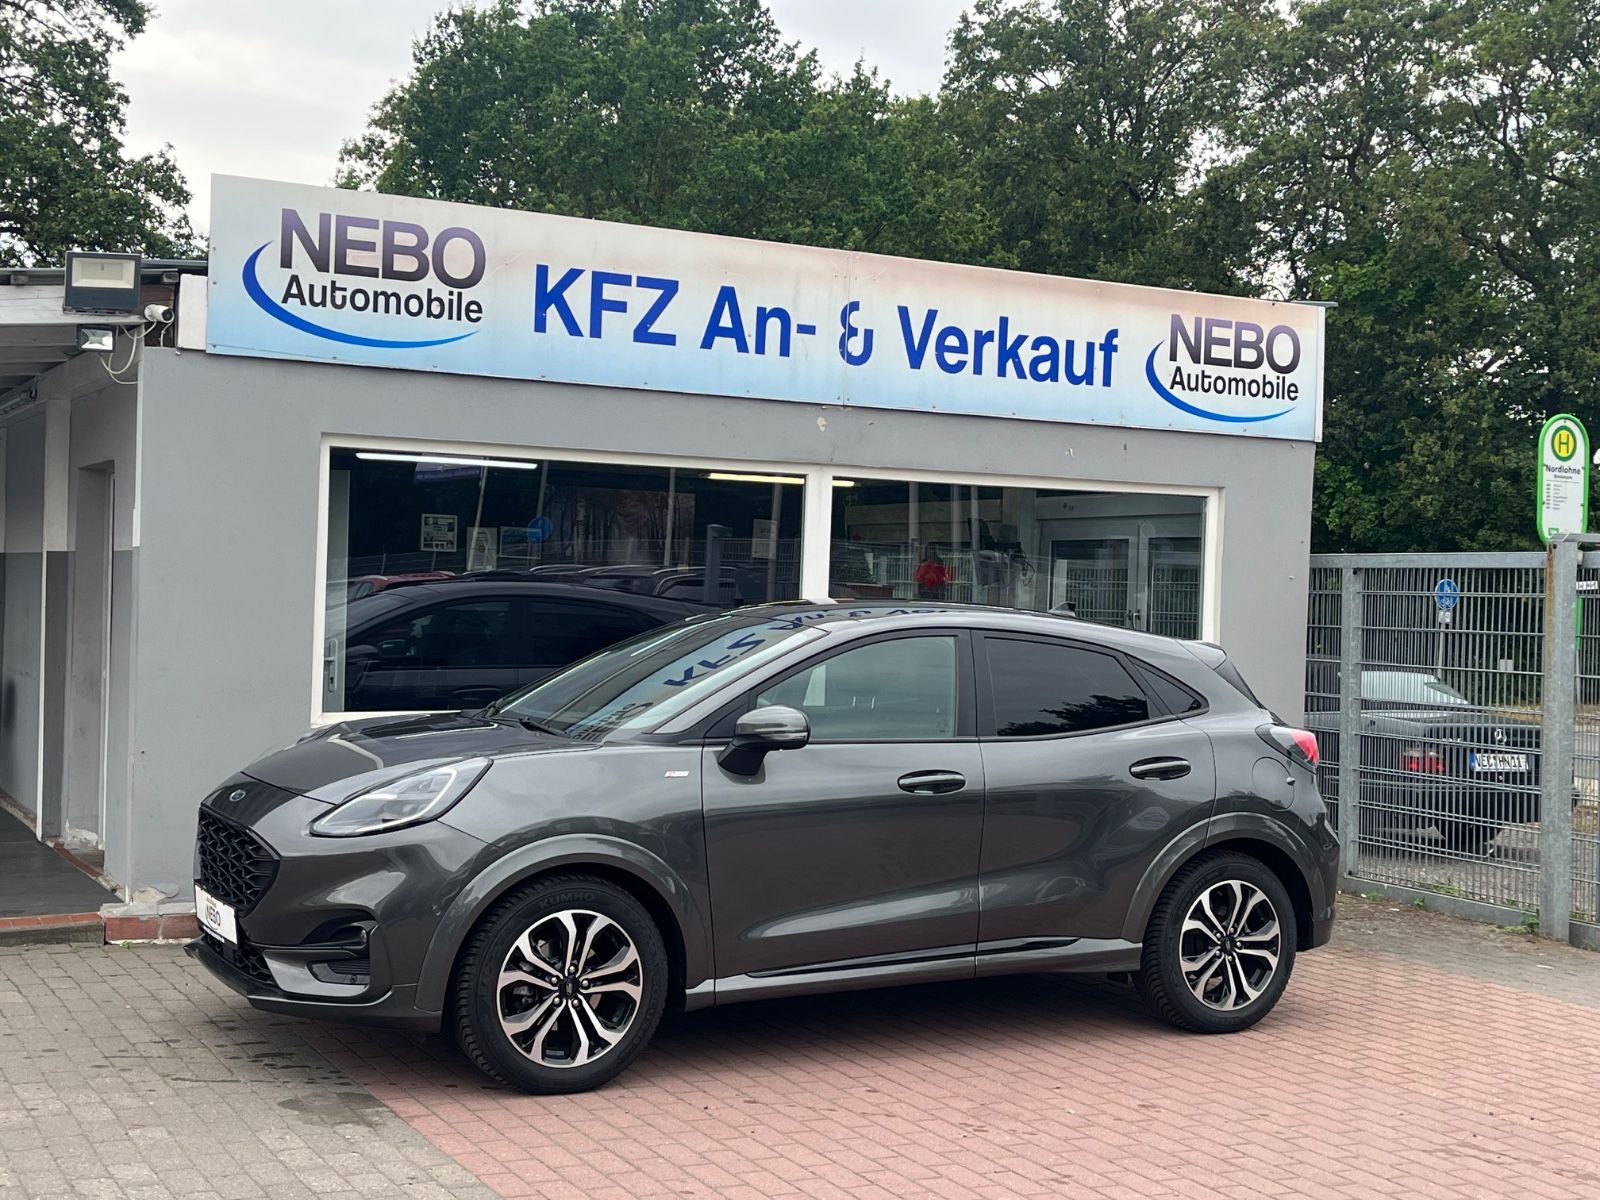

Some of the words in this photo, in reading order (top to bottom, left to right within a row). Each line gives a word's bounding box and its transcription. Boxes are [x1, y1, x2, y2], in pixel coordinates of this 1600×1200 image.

[280, 208, 486, 289] NEBO
[281, 275, 483, 323] Automobile
[534, 264, 679, 346] KFZ
[700, 286, 816, 358] An-
[838, 301, 874, 366] &
[897, 305, 1119, 388] Verkauf
[1169, 314, 1300, 374] NEBO
[1170, 366, 1299, 402] Automobile
[1558, 433, 1569, 454] H
[1545, 465, 1581, 474] Nordlohne
[541, 892, 595, 908] KUMHO
